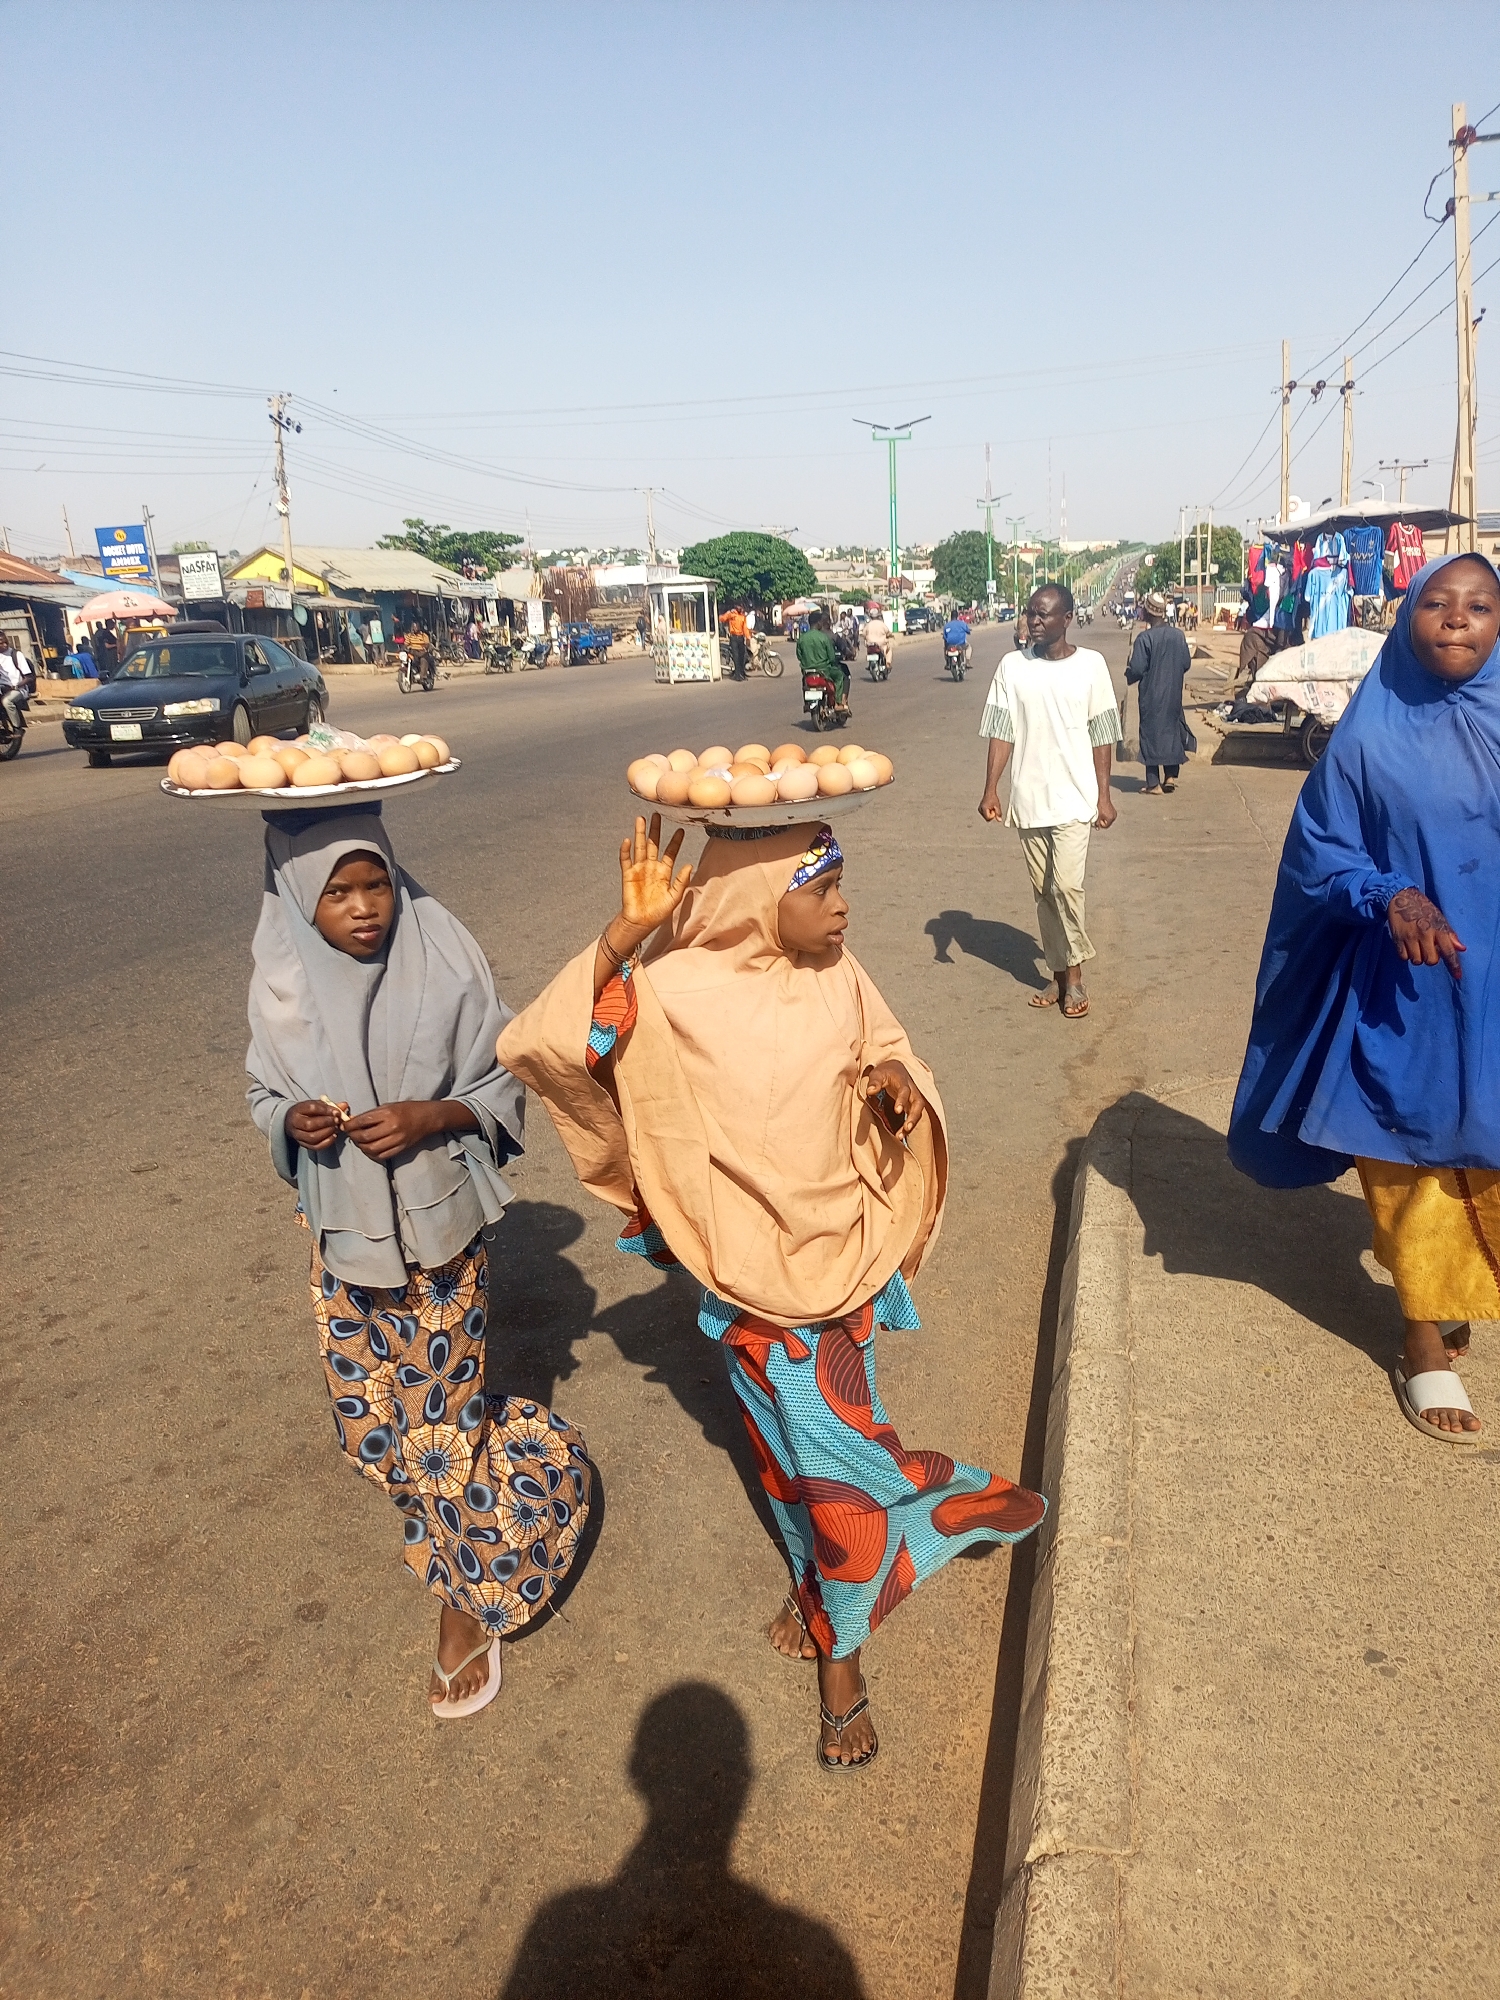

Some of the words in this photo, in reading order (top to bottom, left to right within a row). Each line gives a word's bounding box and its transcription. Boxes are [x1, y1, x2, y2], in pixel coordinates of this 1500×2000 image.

[126, 543, 145, 555] HOTEL
[111, 556, 141, 566] ANNEX
[181, 560, 217, 574] NASFAT
